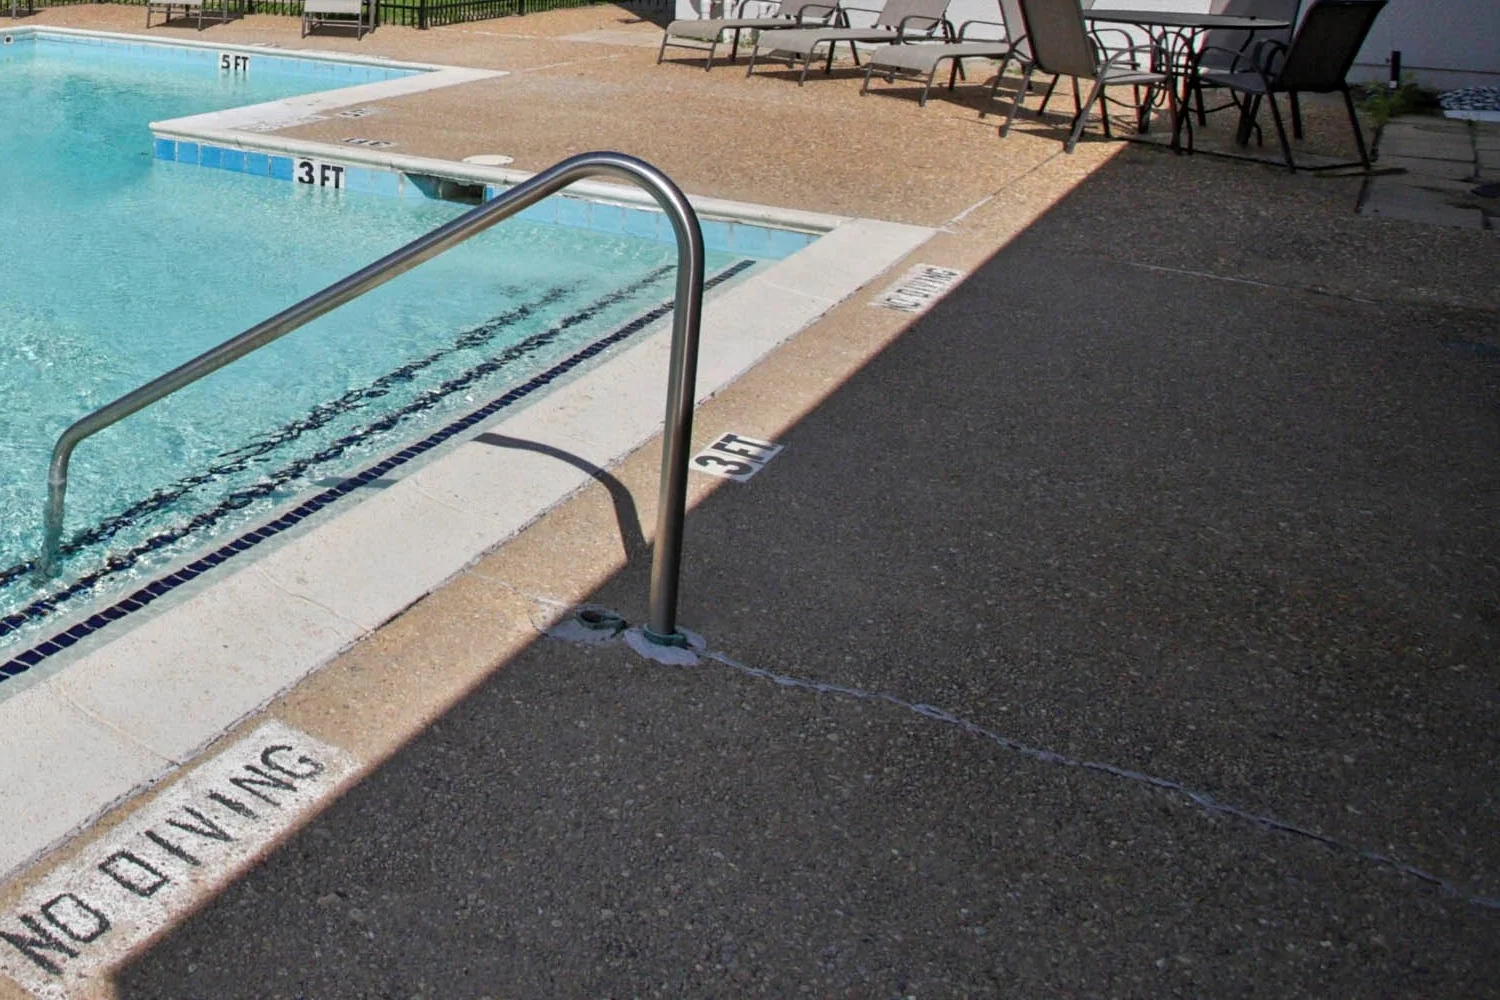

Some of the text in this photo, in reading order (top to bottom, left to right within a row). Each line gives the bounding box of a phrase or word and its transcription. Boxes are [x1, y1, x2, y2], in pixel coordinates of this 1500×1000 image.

[221, 54, 249, 71] 5 FT
[299, 162, 344, 189] 3 FT
[694, 433, 785, 477] 3 FT
[0, 743, 325, 975] NO DIVING
